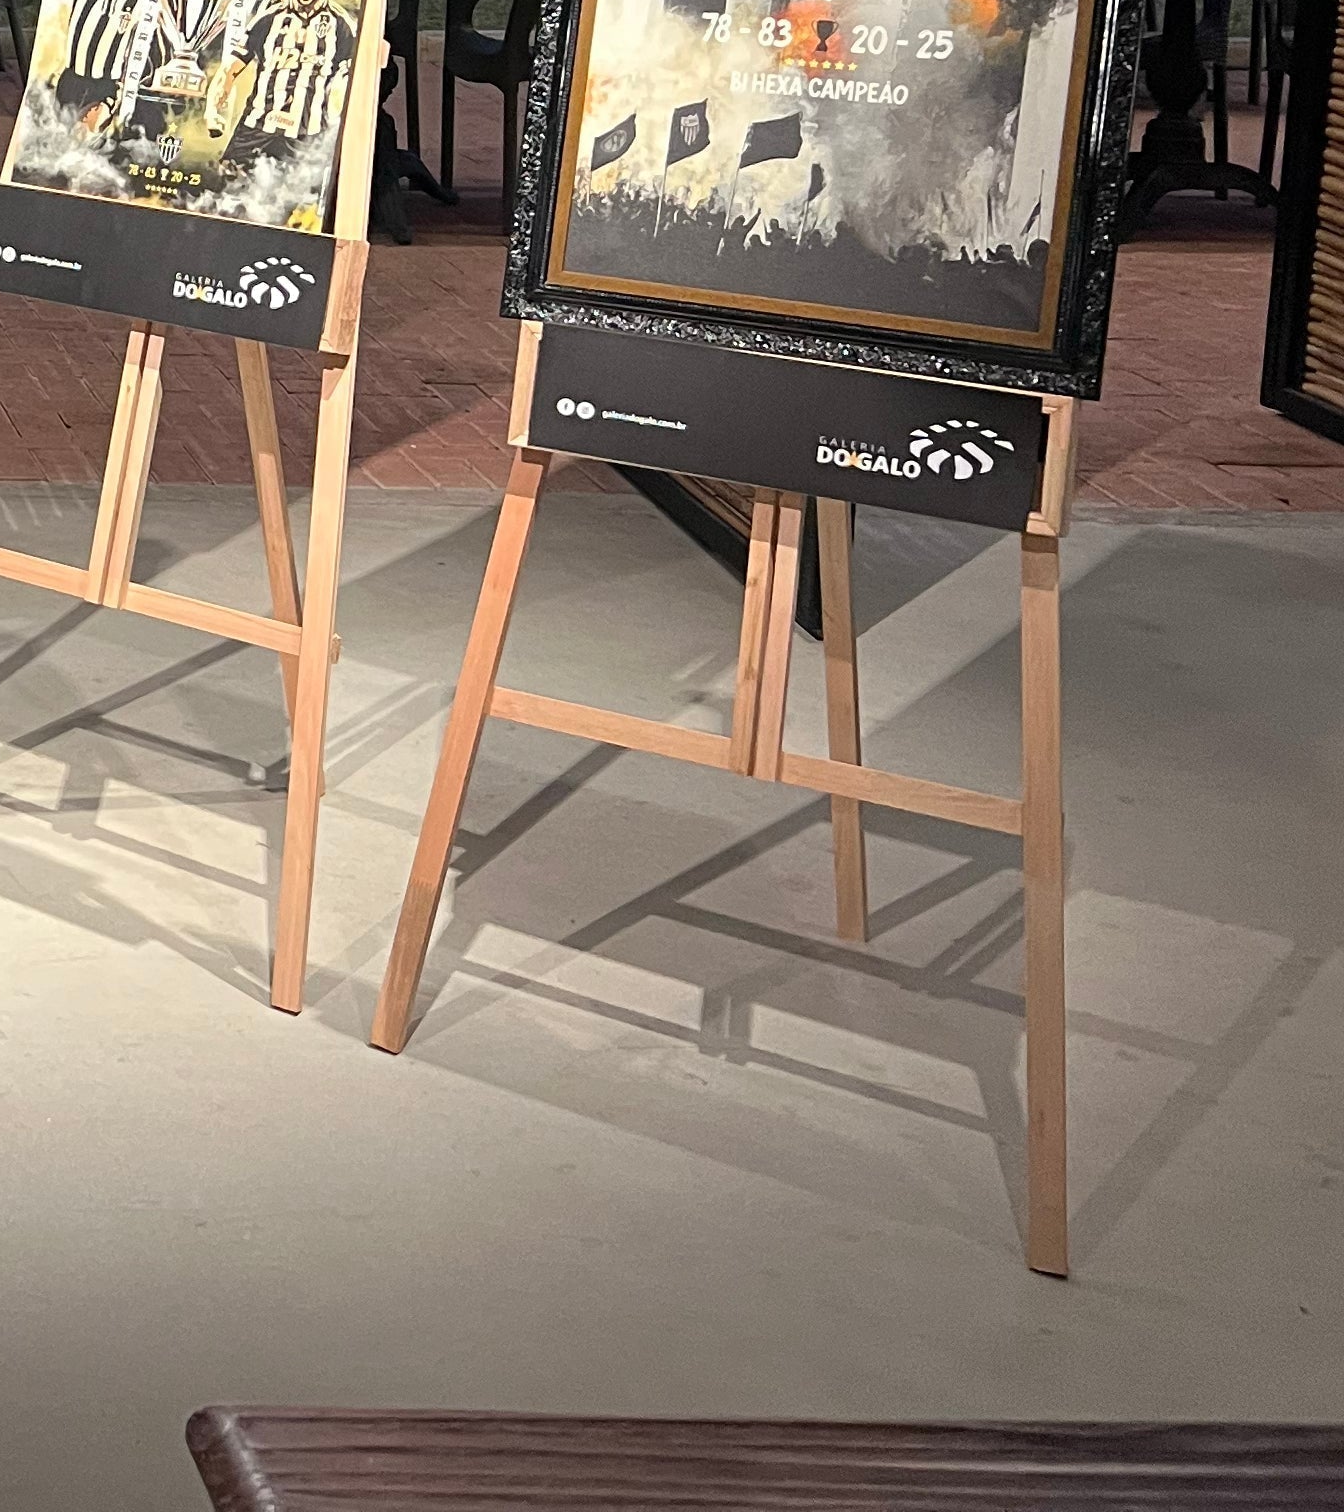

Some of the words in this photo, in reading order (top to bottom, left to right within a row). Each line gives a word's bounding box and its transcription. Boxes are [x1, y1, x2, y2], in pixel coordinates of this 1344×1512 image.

[701, 12, 733, 43] 78
[758, 17, 793, 48] 83
[850, 25, 888, 56] 20
[916, 30, 955, 60] 25
[730, 70, 748, 93] BI
[752, 72, 803, 97] HEXA
[819, 436, 886, 455] GALERIA
